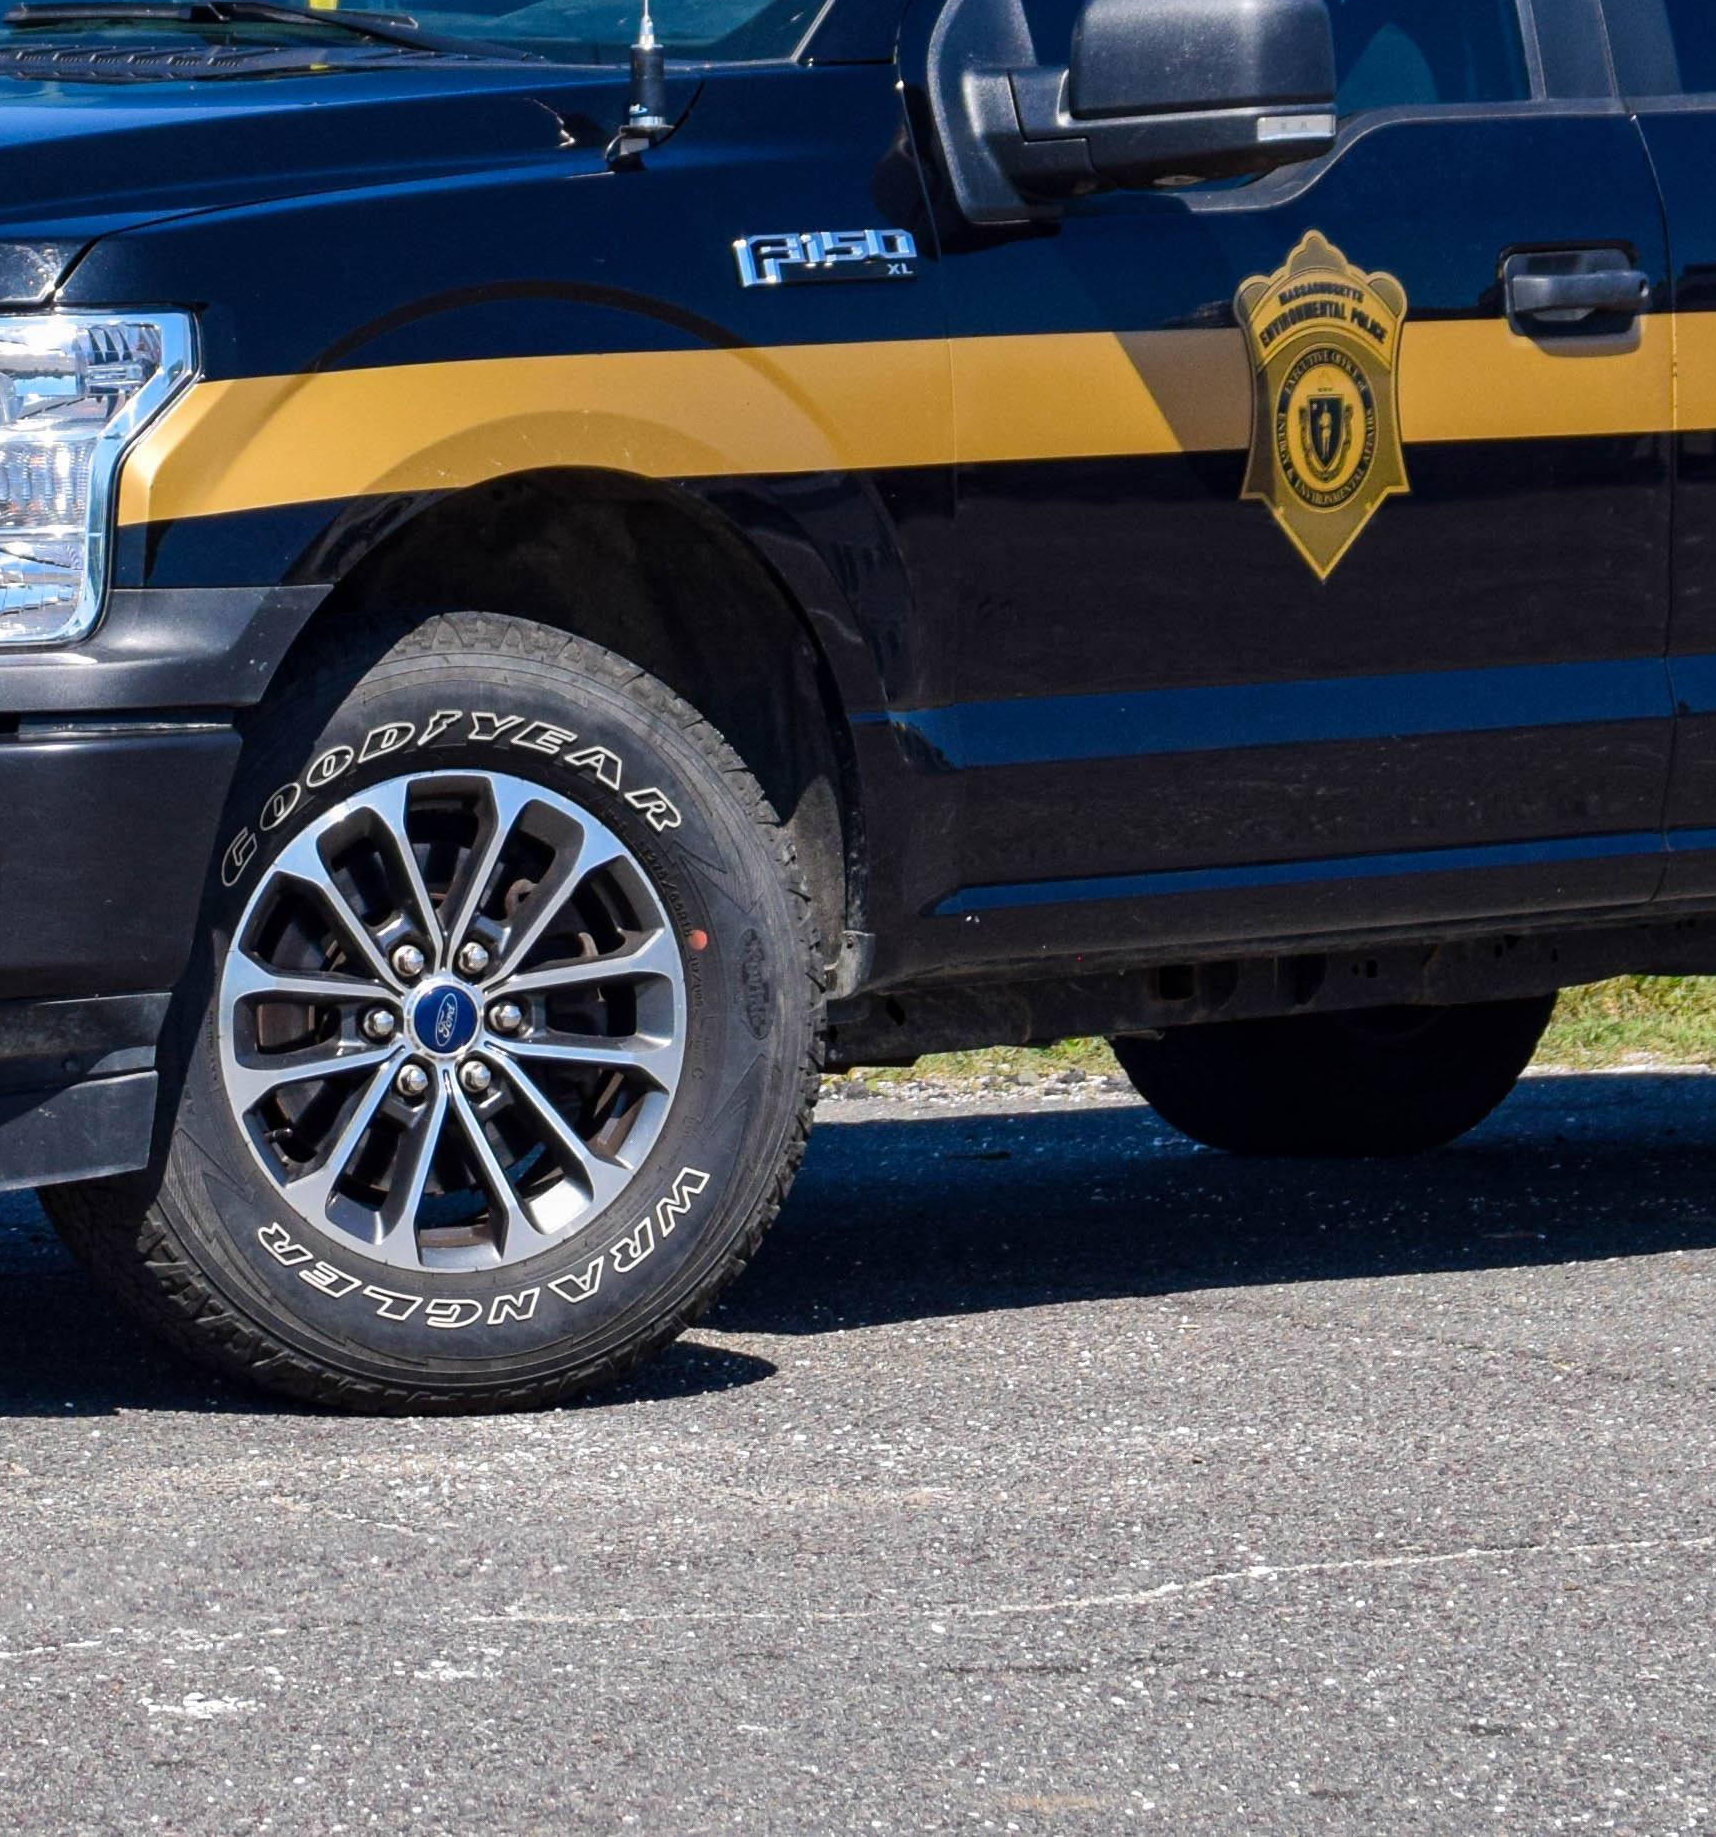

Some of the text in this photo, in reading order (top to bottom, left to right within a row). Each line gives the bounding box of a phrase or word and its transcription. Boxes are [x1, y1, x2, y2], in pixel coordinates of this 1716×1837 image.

[887, 263, 913, 275] XL
[1259, 300, 1388, 348] ENVIRONMENTAL POLICE
[220, 708, 683, 888] GOODYEAR
[437, 1002, 456, 1038] Ford
[257, 1164, 710, 1328] WRANGLER
